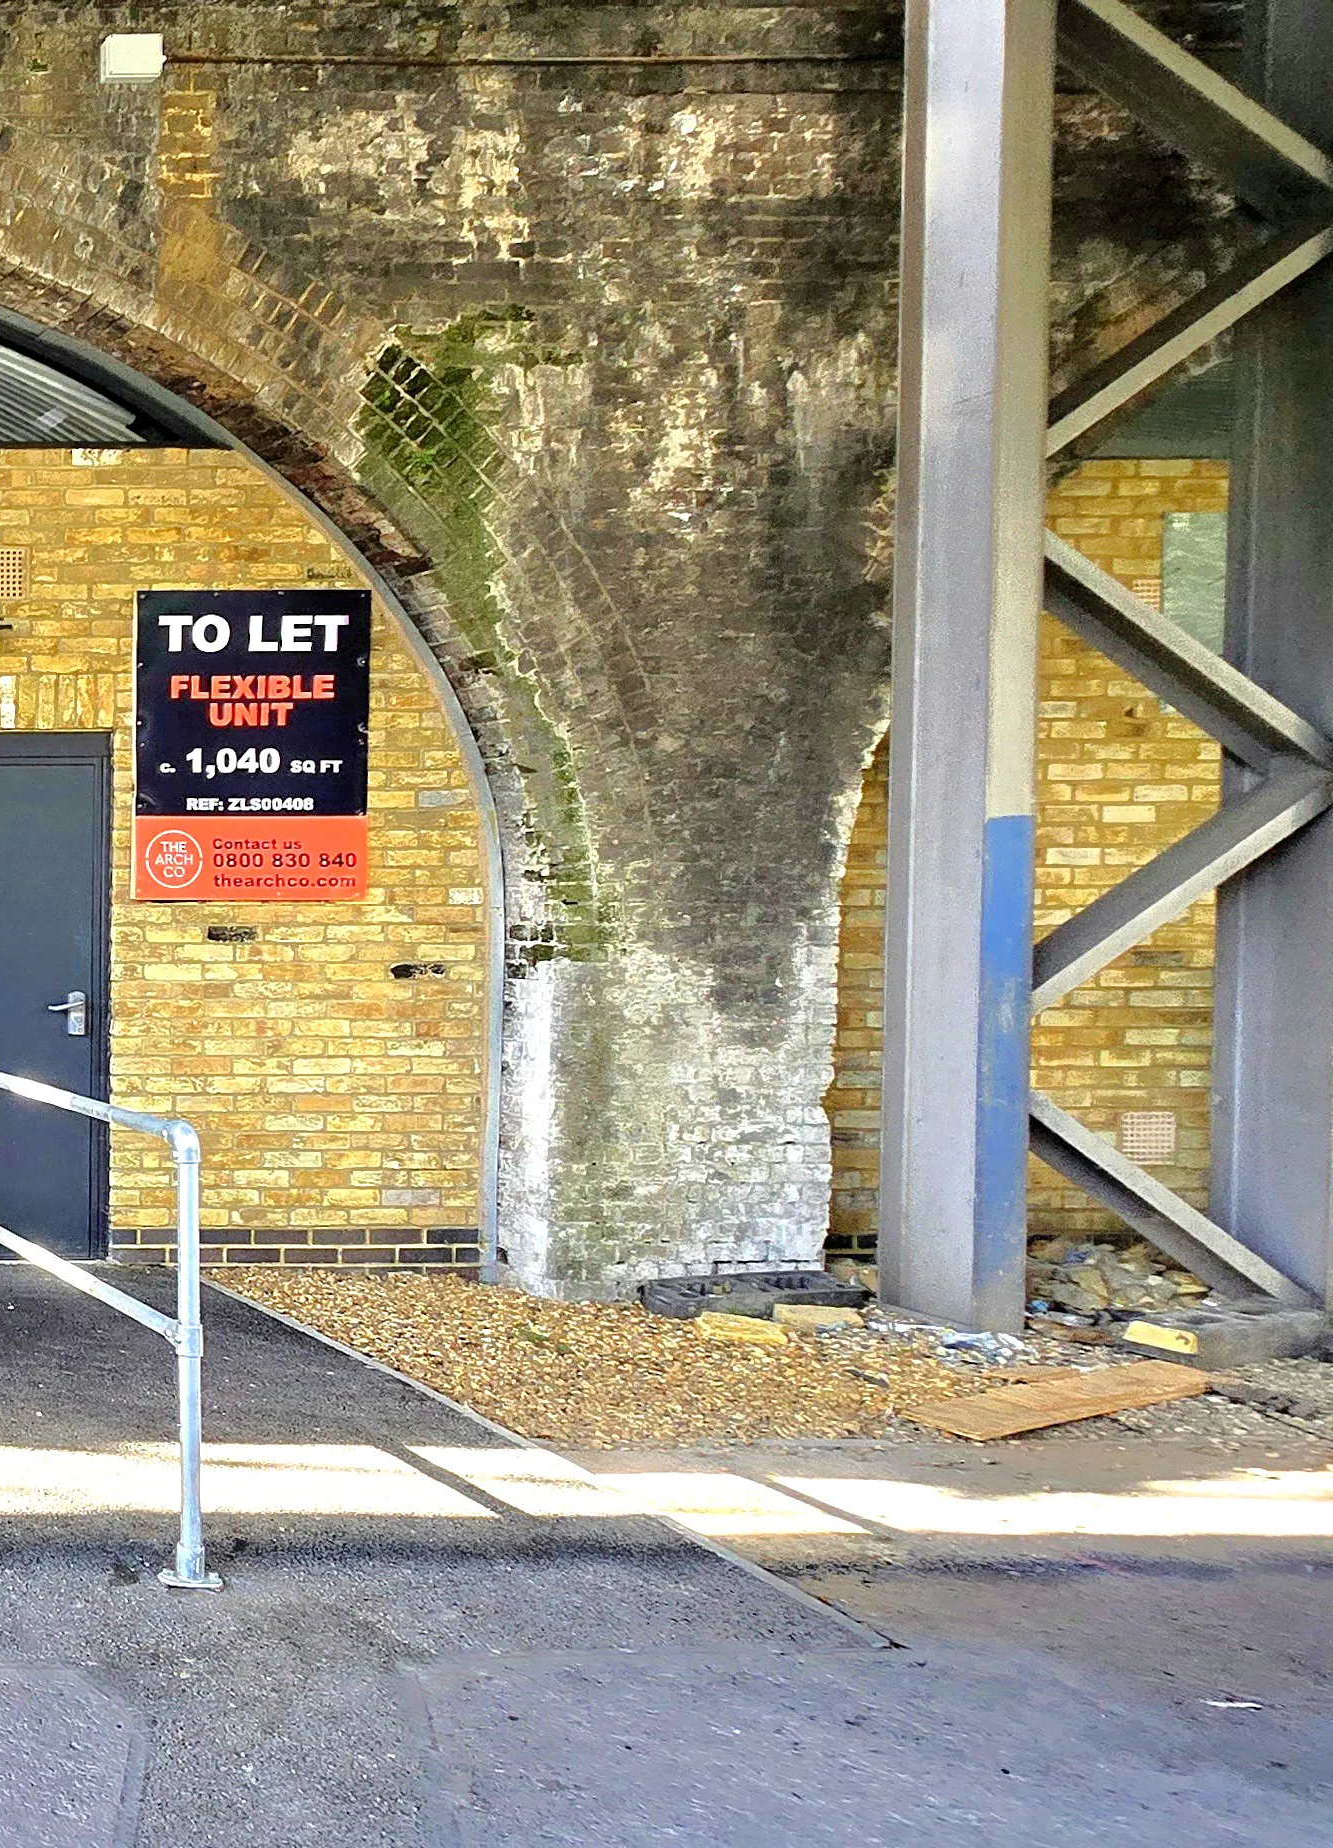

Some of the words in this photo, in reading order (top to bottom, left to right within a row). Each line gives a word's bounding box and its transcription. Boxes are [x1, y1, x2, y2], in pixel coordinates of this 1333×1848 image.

[158, 614, 230, 653] TO
[248, 615, 349, 652] LET
[170, 675, 335, 700] FLEXIBLE
[209, 702, 294, 726] UNIT
[160, 762, 176, 773] c.
[186, 748, 280, 779] 1,040
[290, 759, 315, 774] SQ
[320, 760, 343, 773] FT
[186, 798, 223, 811] REF:
[227, 798, 314, 811] ZLS00408
[161, 841, 187, 853] THE
[213, 838, 277, 850] Contact
[284, 840, 302, 850] us
[155, 854, 193, 866] ARCH
[213, 853, 263, 868] 0800
[272, 853, 310, 867] 830
[319, 853, 357, 867] 840
[163, 866, 185, 878] CO
[214, 874, 356, 888] thearchco.com
